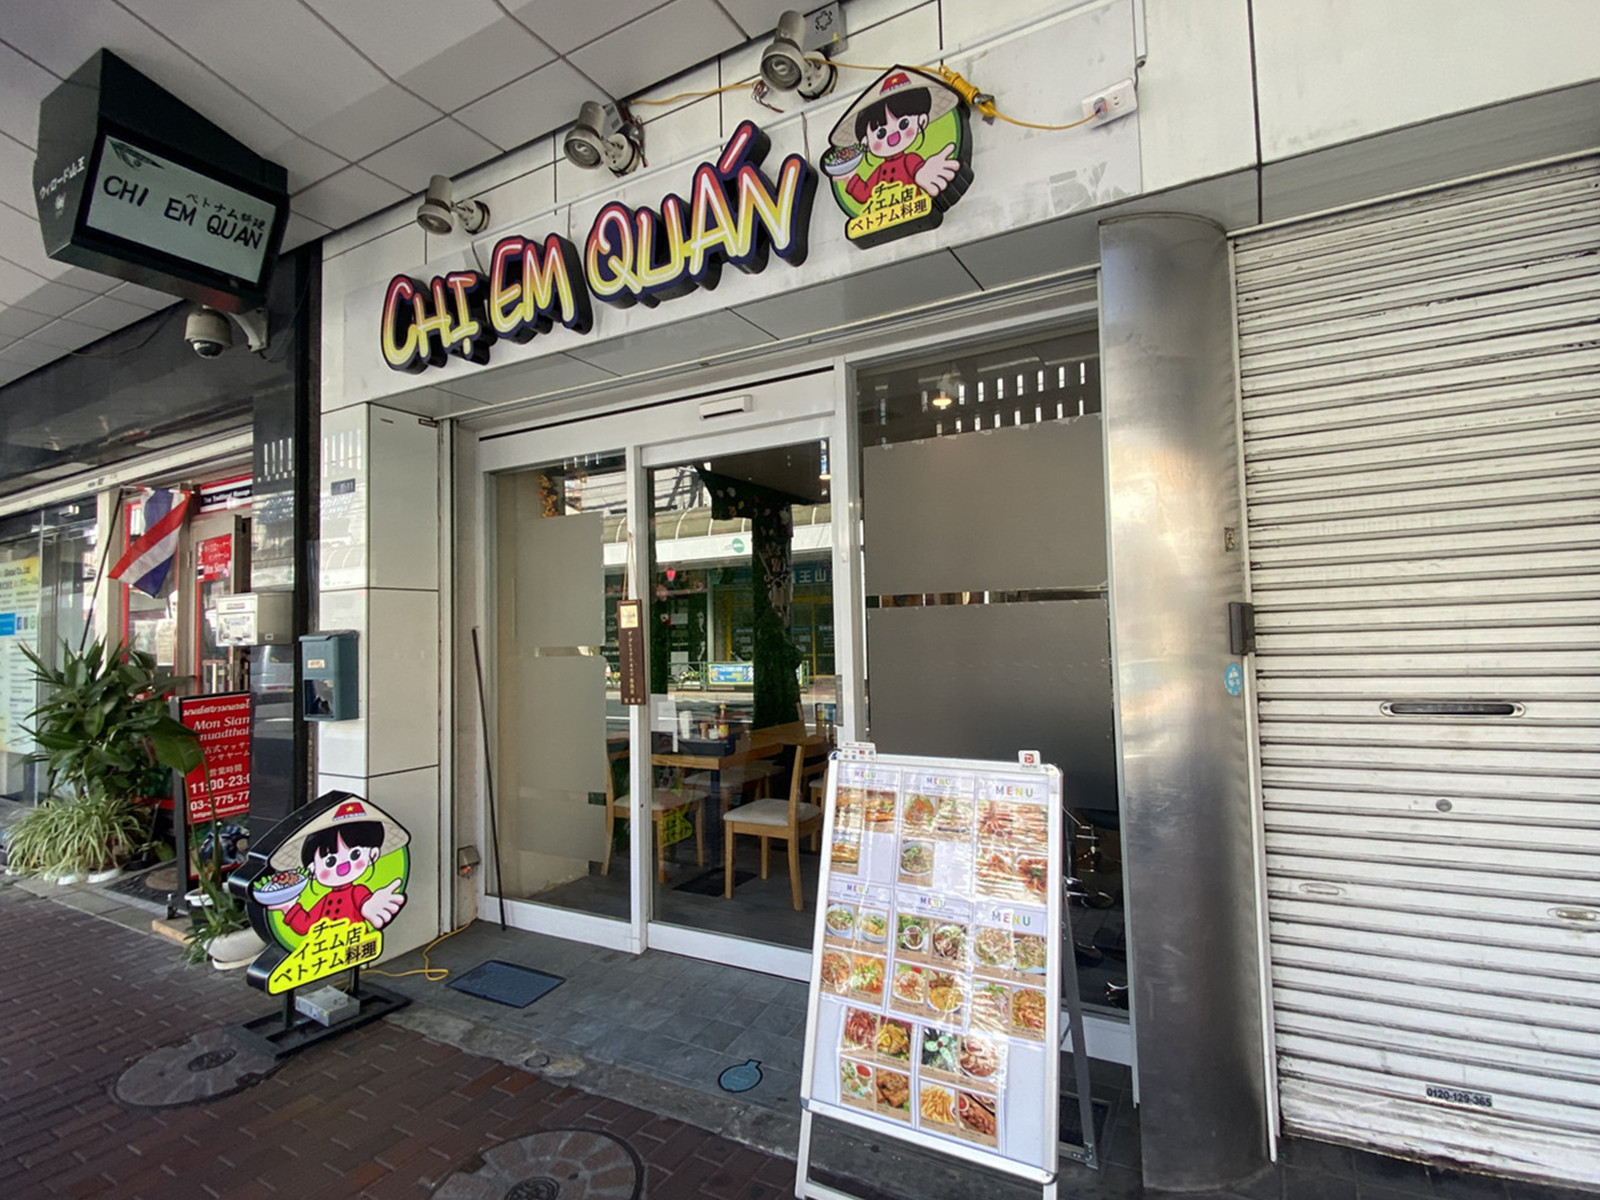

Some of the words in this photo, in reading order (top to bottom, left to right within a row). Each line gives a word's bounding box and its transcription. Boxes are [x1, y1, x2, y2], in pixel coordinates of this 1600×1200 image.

[862, 187, 914, 214] イエム店
[874, 183, 900, 199] チー
[103, 175, 149, 207] CHI
[164, 197, 197, 226] EM
[207, 214, 263, 249] QUAN
[851, 198, 927, 231] ベトナム料理
[488, 234, 579, 334] EM
[586, 120, 807, 300] QUÁN
[193, 719, 221, 731] Mon
[995, 785, 1034, 798] MENU
[991, 910, 1031, 926] MENU
[312, 921, 346, 939] チー
[293, 926, 362, 960] イエム店
[273, 941, 377, 983] ベトナム料理
[1426, 1087, 1492, 1107] 0120-129-365
